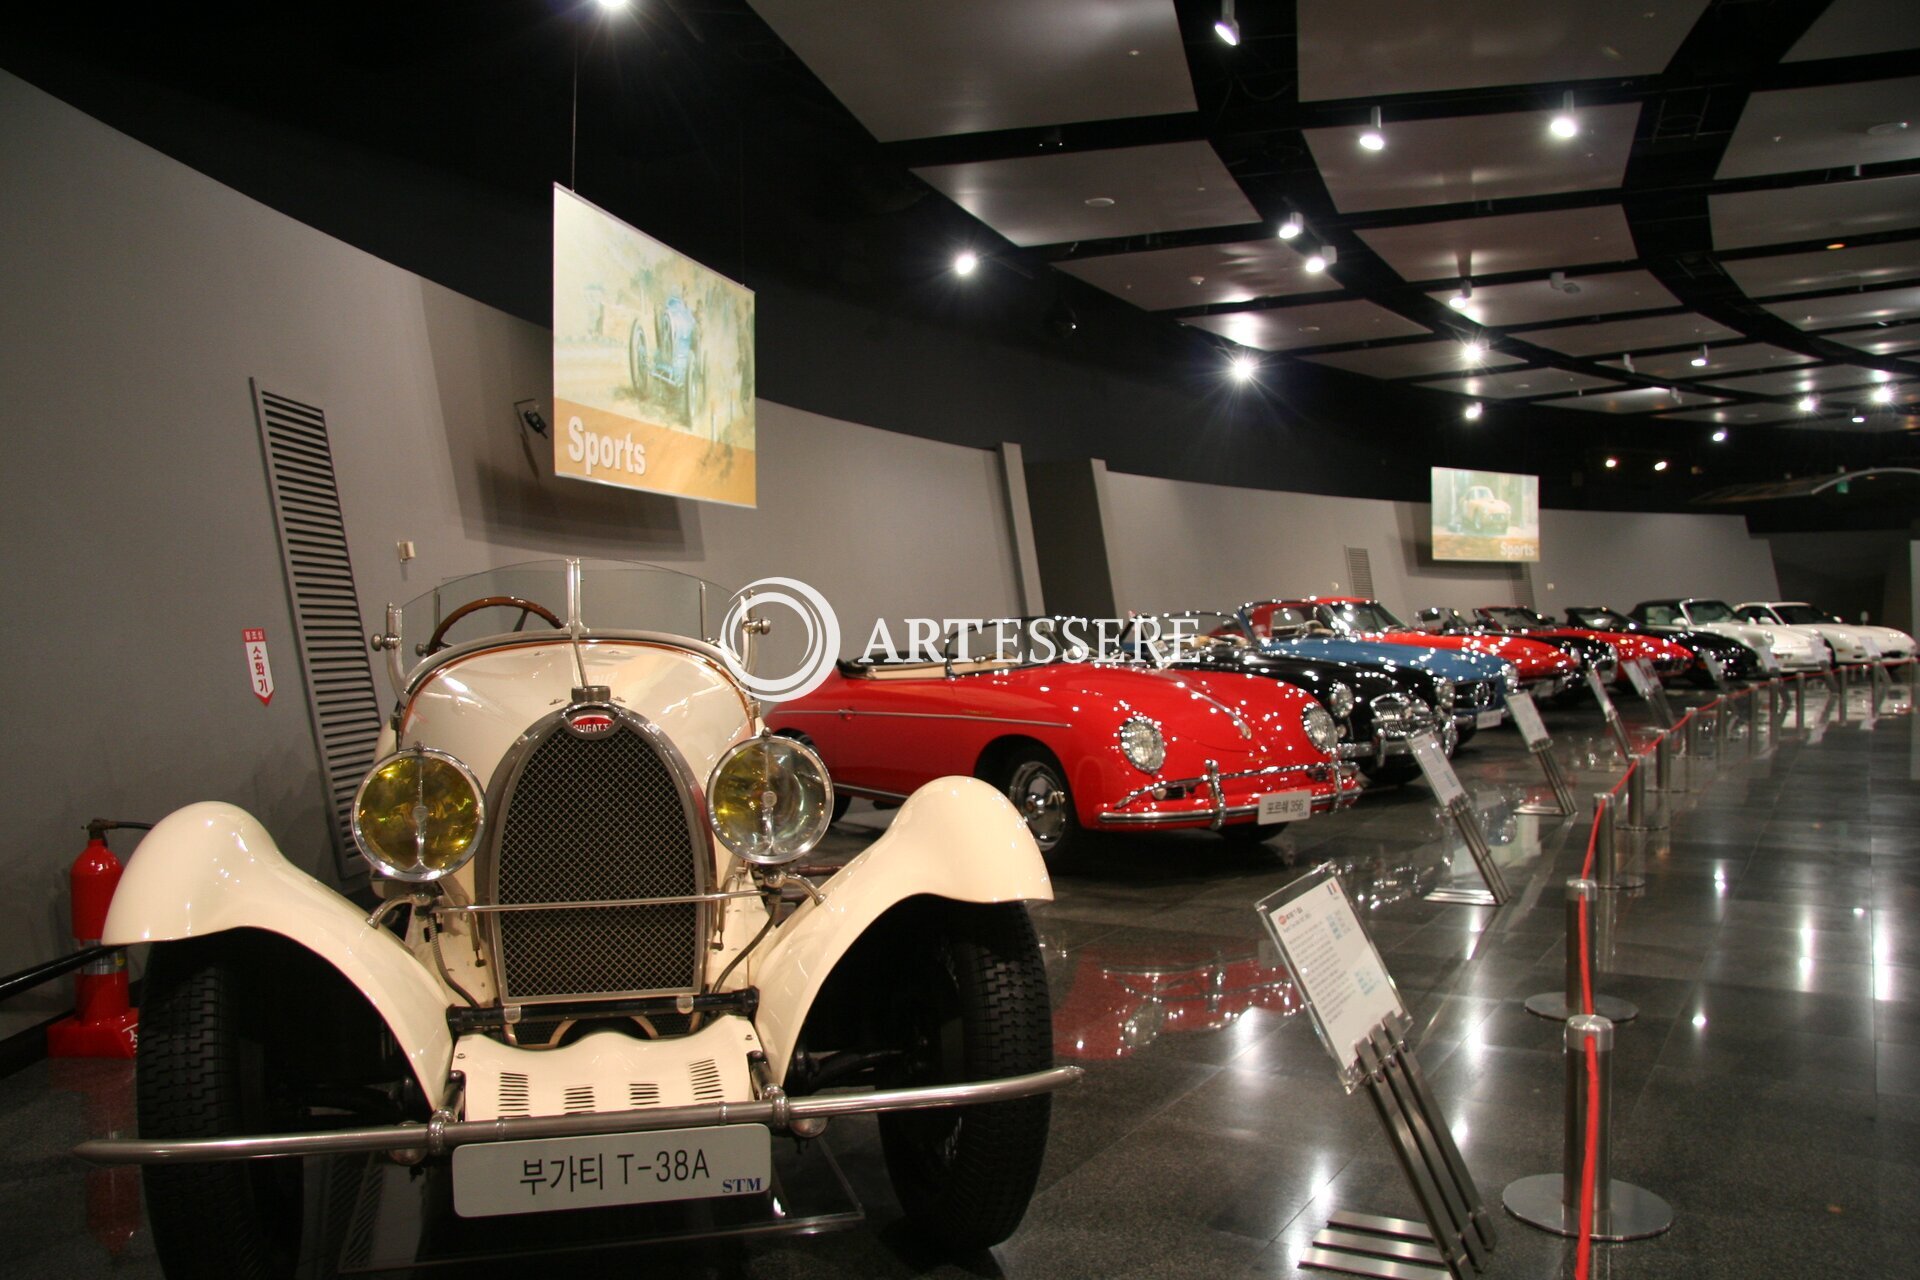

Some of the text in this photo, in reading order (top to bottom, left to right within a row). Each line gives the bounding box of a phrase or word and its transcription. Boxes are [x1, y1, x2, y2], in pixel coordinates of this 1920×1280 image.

[568, 415, 646, 475] Sports
[1500, 541, 1535, 559] Sports
[253, 646, 268, 693] 소화기
[520, 1149, 710, 1195] 부가티 T-38A
[722, 1177, 762, 1193] STM
